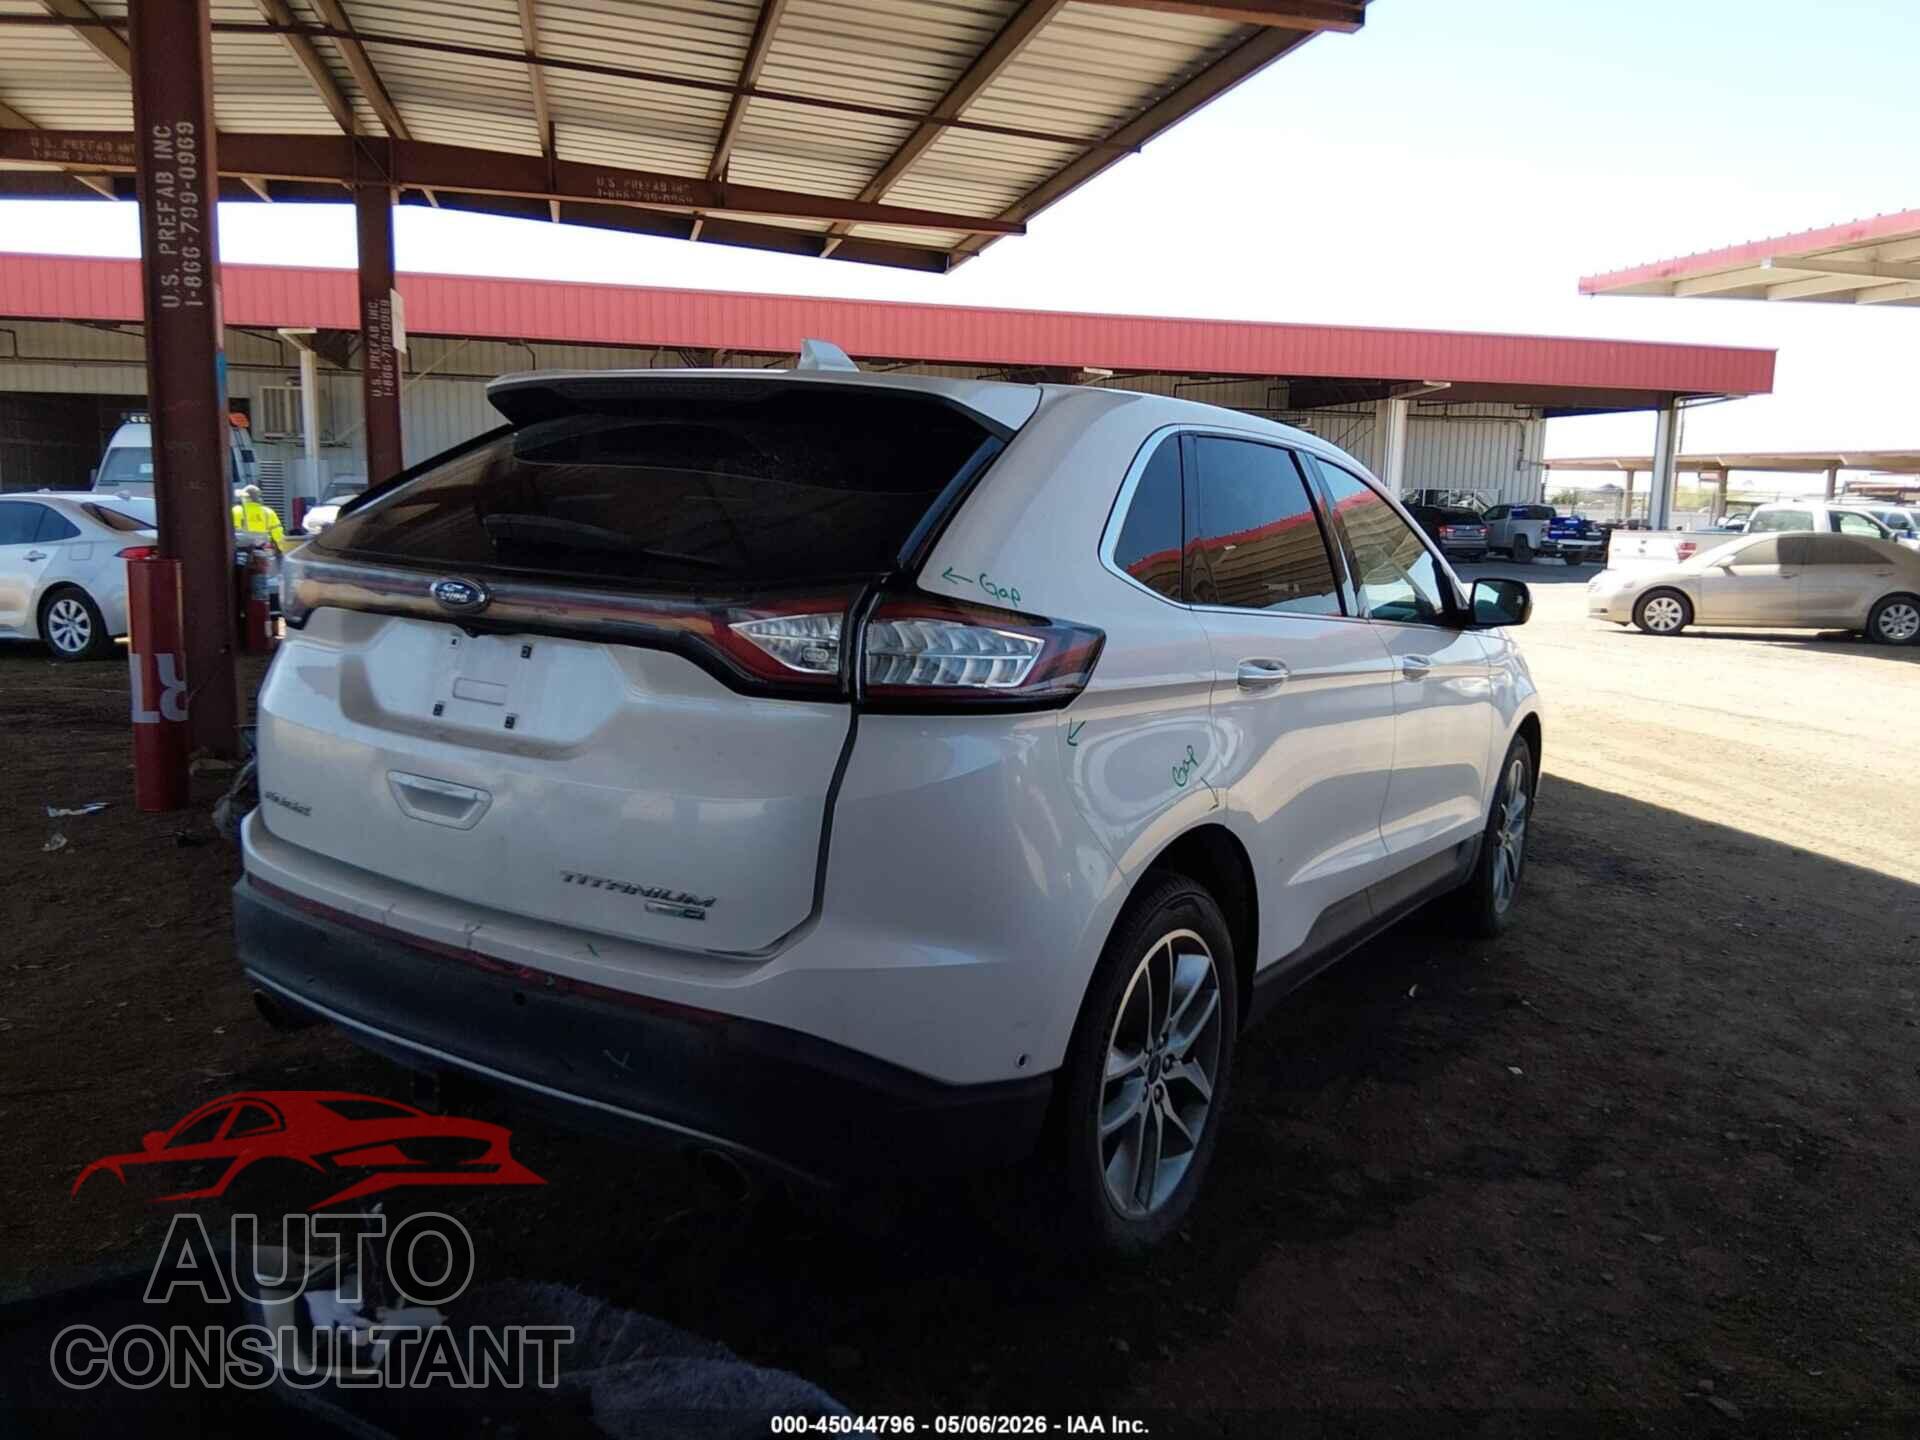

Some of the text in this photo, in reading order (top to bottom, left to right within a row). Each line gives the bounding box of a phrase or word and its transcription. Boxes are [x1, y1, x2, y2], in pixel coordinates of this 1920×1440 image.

[152, 124, 181, 309] U.S. PREFAB INC
[176, 121, 203, 306] 1-866-799-0969
[979, 572, 1021, 608] Gap
[560, 870, 718, 908] TITANIUM
